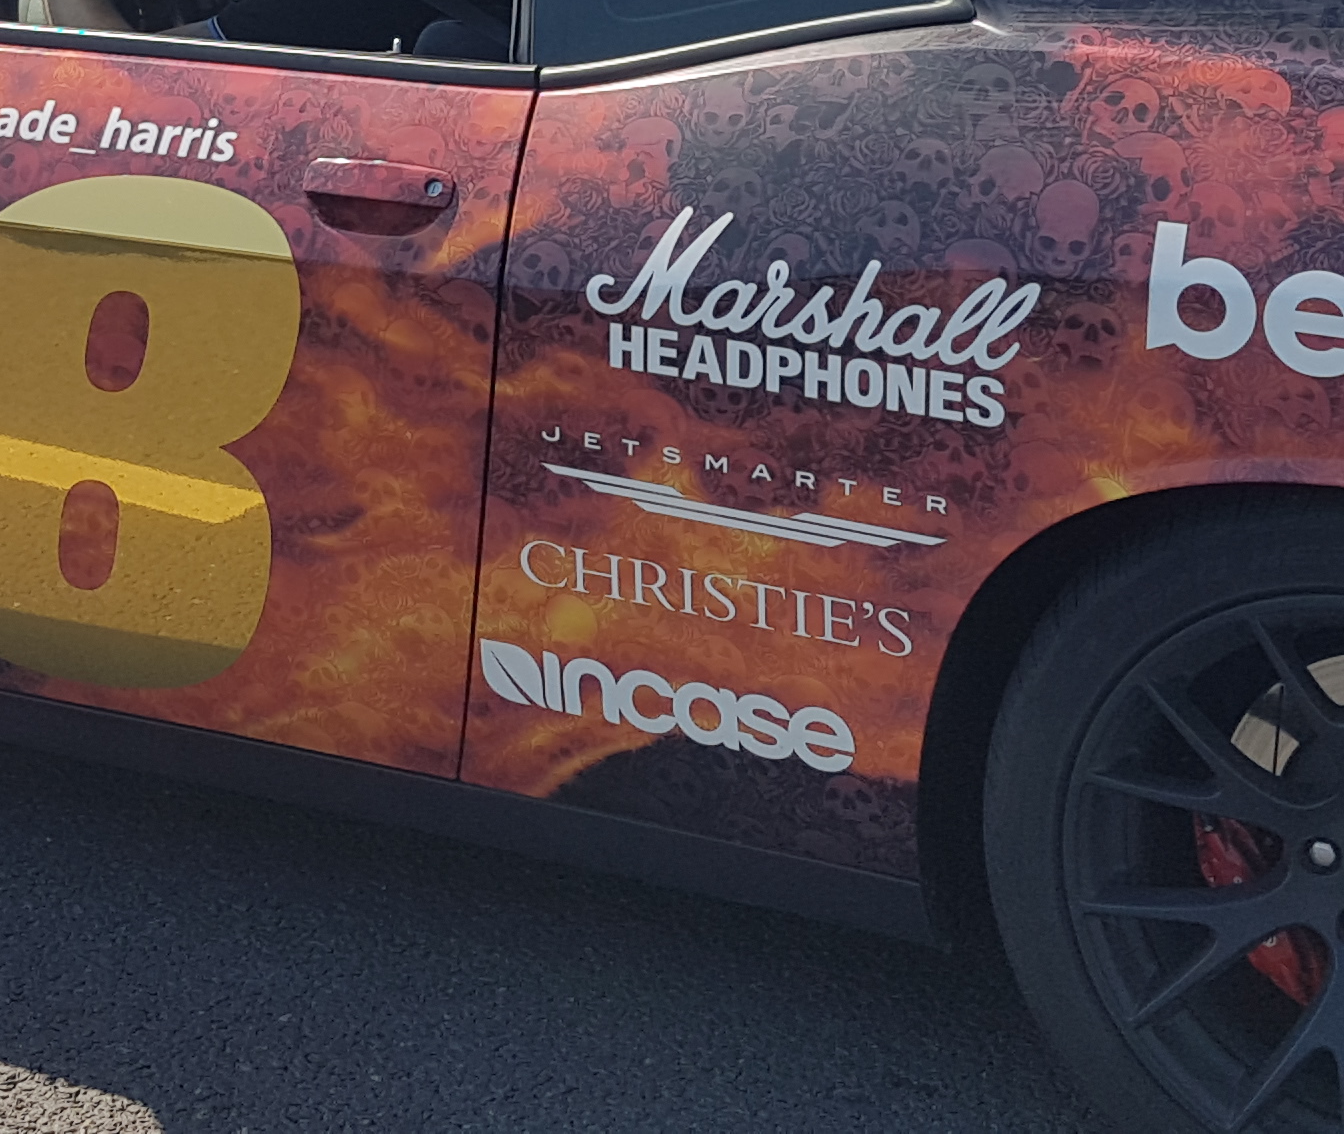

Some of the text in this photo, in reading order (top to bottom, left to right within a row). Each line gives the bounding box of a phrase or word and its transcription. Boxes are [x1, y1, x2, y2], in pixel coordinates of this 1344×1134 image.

[586, 206, 1041, 370] Marshall
[609, 322, 1005, 427] HEADPHONES
[542, 427, 948, 514] JETSMARTER
[519, 540, 913, 657] CHRISTIE'S
[542, 650, 855, 772] incase
